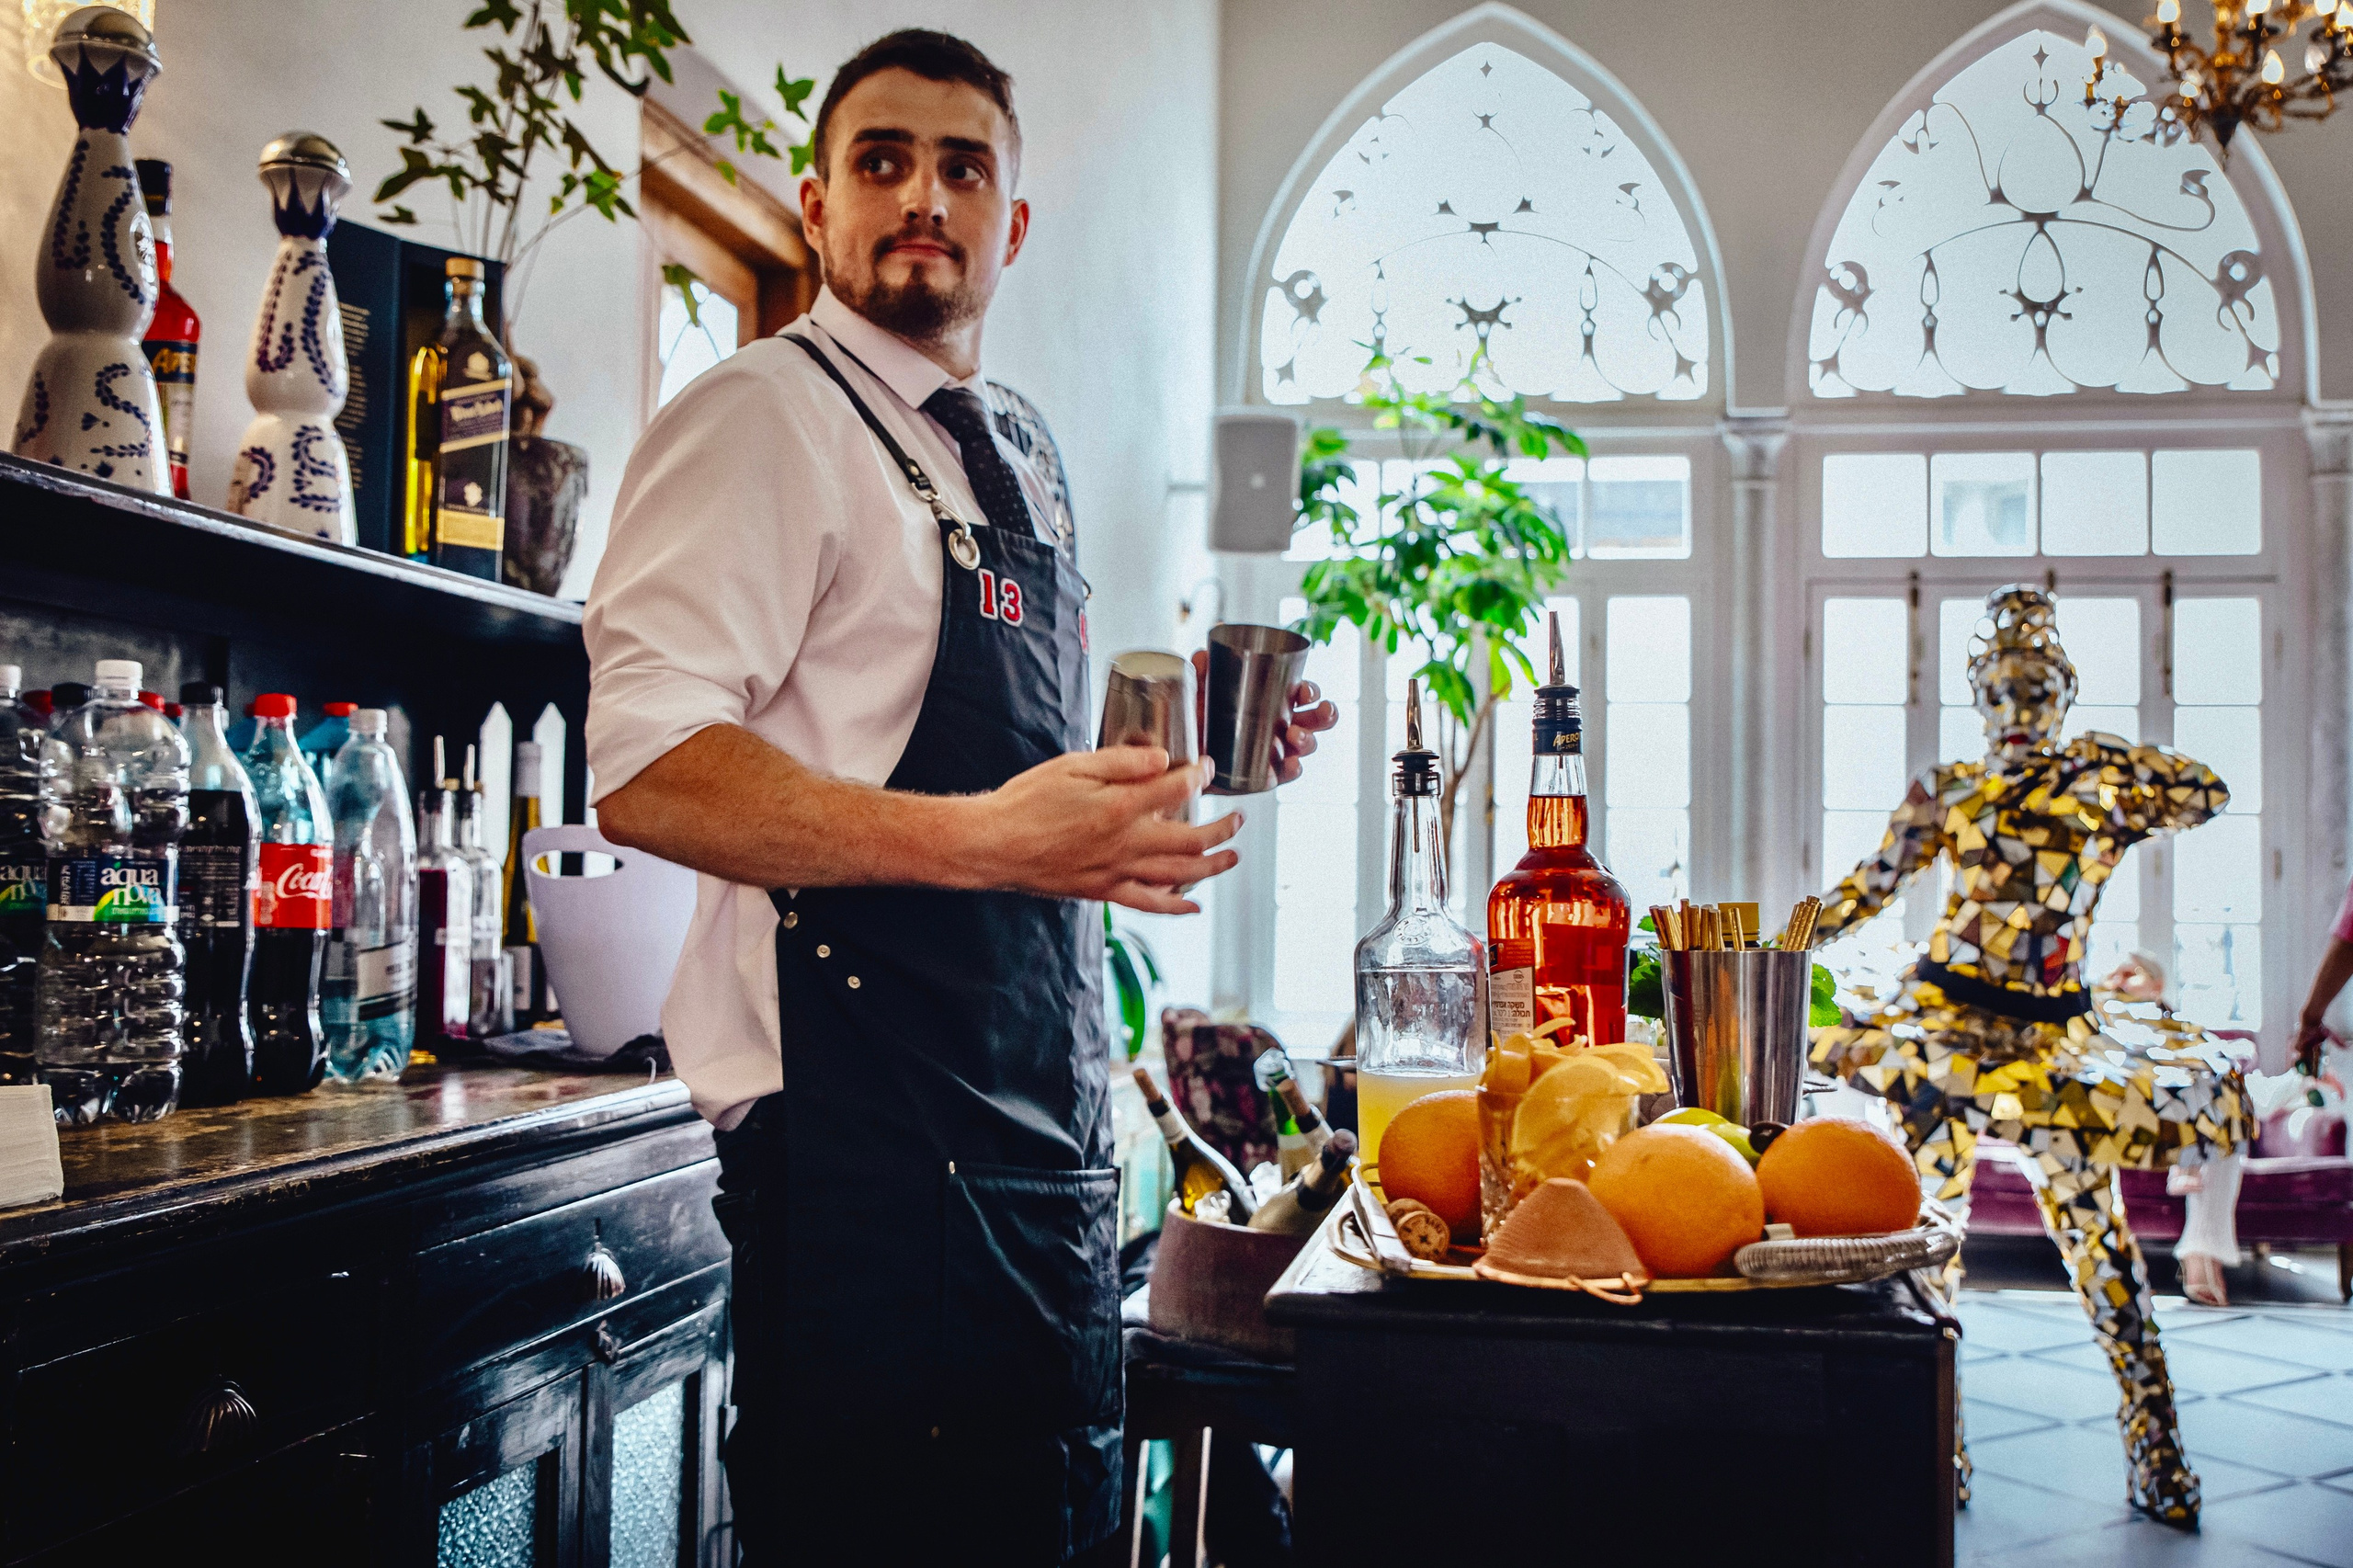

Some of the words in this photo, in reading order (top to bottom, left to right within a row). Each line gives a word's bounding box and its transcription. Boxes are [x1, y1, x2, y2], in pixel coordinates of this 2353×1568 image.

[978, 568, 1023, 627] 13
[100, 867, 159, 887] aqua
[112, 884, 163, 906] nova
